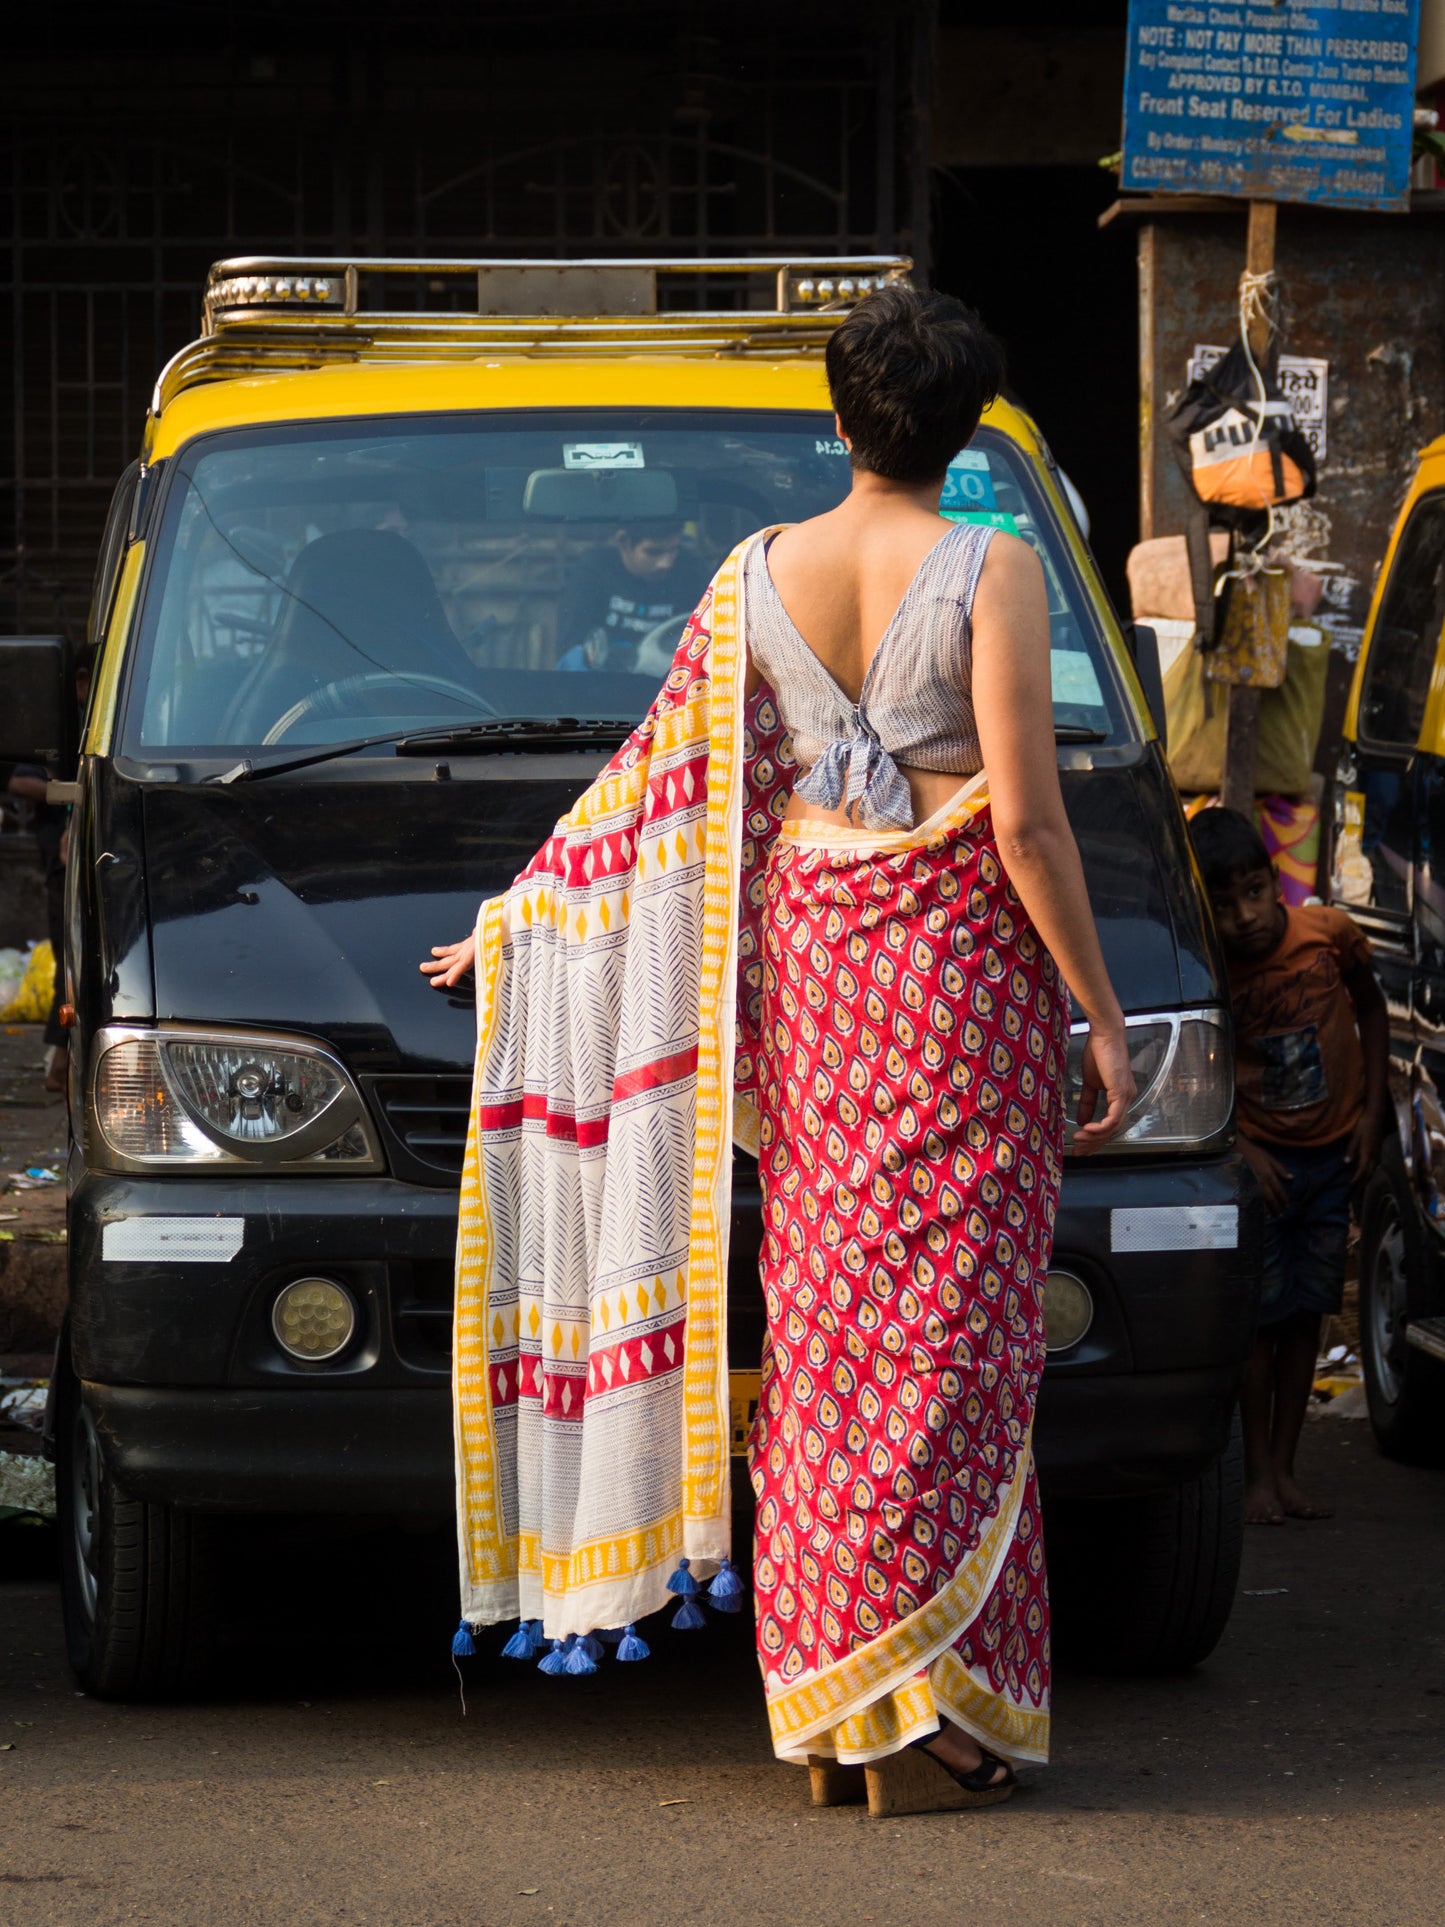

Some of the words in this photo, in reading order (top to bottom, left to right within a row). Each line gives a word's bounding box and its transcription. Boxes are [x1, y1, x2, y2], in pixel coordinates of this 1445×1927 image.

[1185, 29, 1214, 50] NOT
[1216, 31, 1241, 52] PAY
[1244, 33, 1283, 55] MORE
[1286, 35, 1322, 56] THAN
[1325, 38, 1408, 62] PRESCRIBED
[1158, 50, 1203, 72] Complaint
[1204, 53, 1241, 73] Contact
[1167, 73, 1242, 93] APPROVED
[1244, 77, 1264, 95] BY
[1139, 92, 1184, 116] Front
[1188, 95, 1228, 119] Seat
[1231, 98, 1310, 124] Reserved
[1315, 103, 1343, 126] For
[1346, 105, 1402, 130] Ladies
[1147, 130, 1161, 152] By
[1280, 370, 1320, 392] हिये
